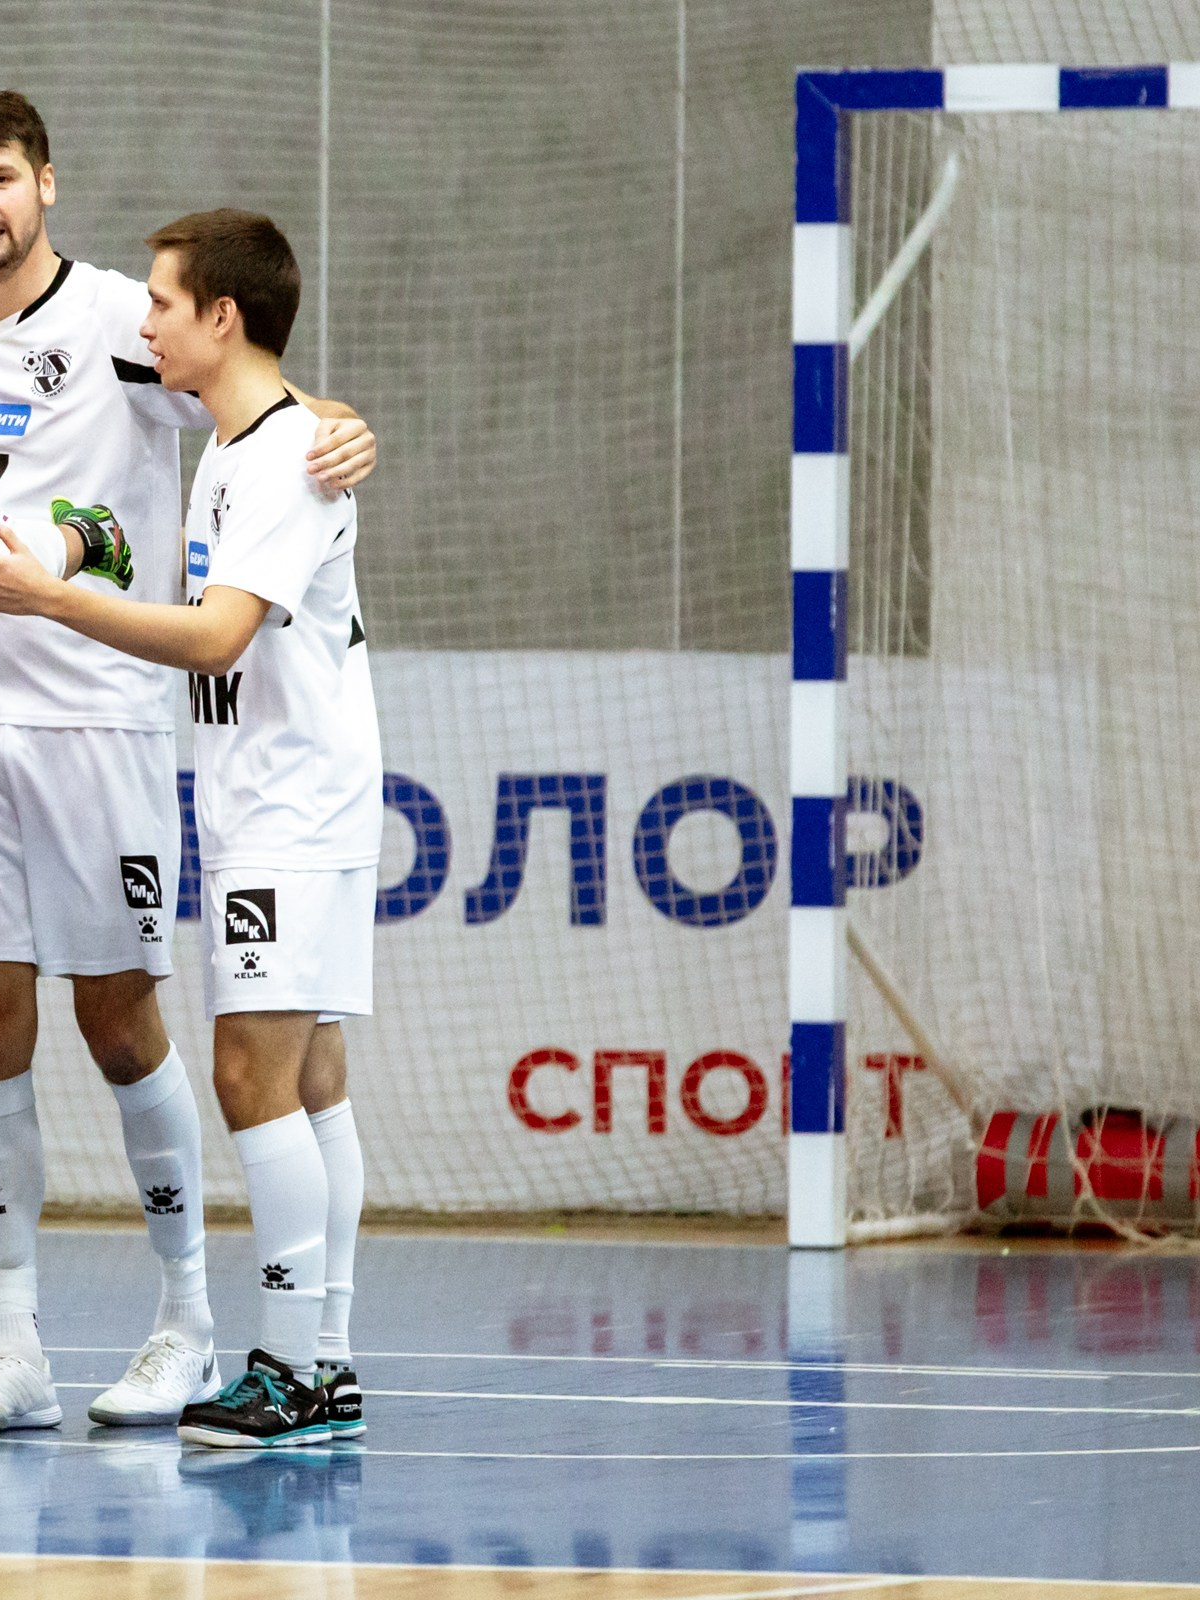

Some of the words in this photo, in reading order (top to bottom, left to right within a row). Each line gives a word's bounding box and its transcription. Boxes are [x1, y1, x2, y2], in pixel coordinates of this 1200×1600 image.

[176, 771, 924, 928] ОЛОР
[139, 935, 163, 943] ELME
[234, 971, 268, 980] KELME
[507, 1046, 928, 1140] СПОТ
[145, 1203, 184, 1215] KELME
[261, 1281, 295, 1291] KELME
